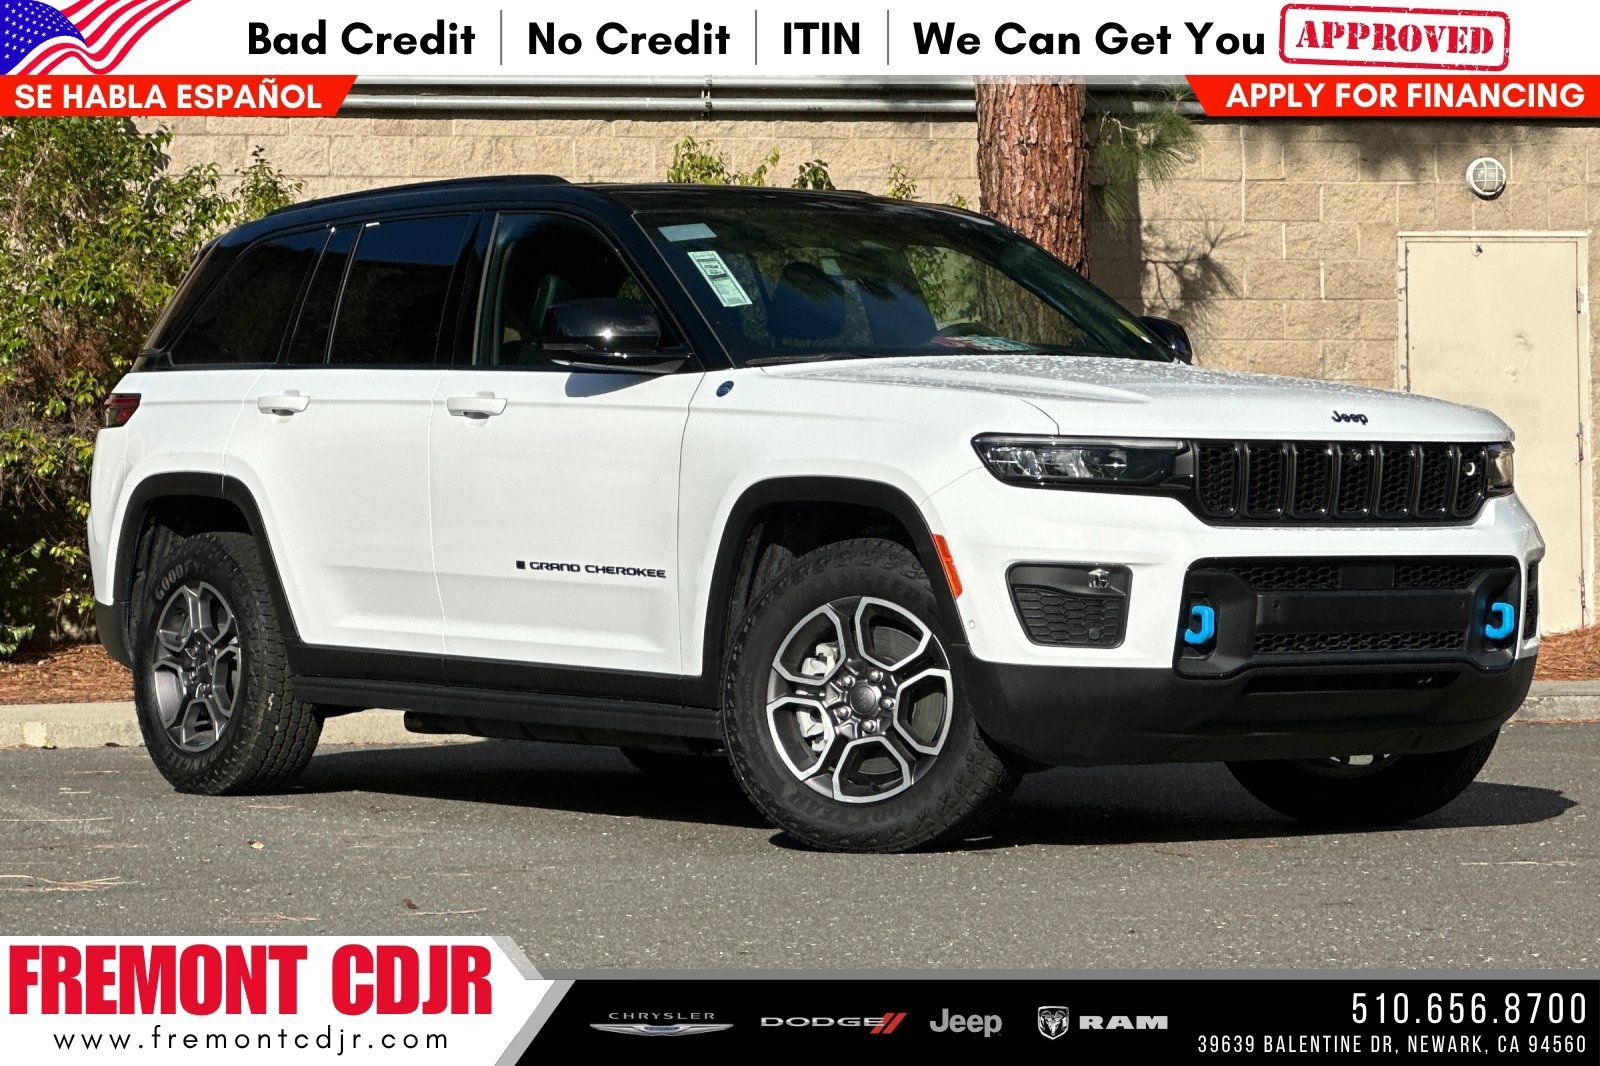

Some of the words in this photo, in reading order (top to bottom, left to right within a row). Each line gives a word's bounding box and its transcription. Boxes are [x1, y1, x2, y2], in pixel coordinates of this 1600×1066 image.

[1331, 410, 1369, 426] Jeep
[529, 561, 581, 573] GRAND
[584, 564, 666, 578] CHEROKEE
